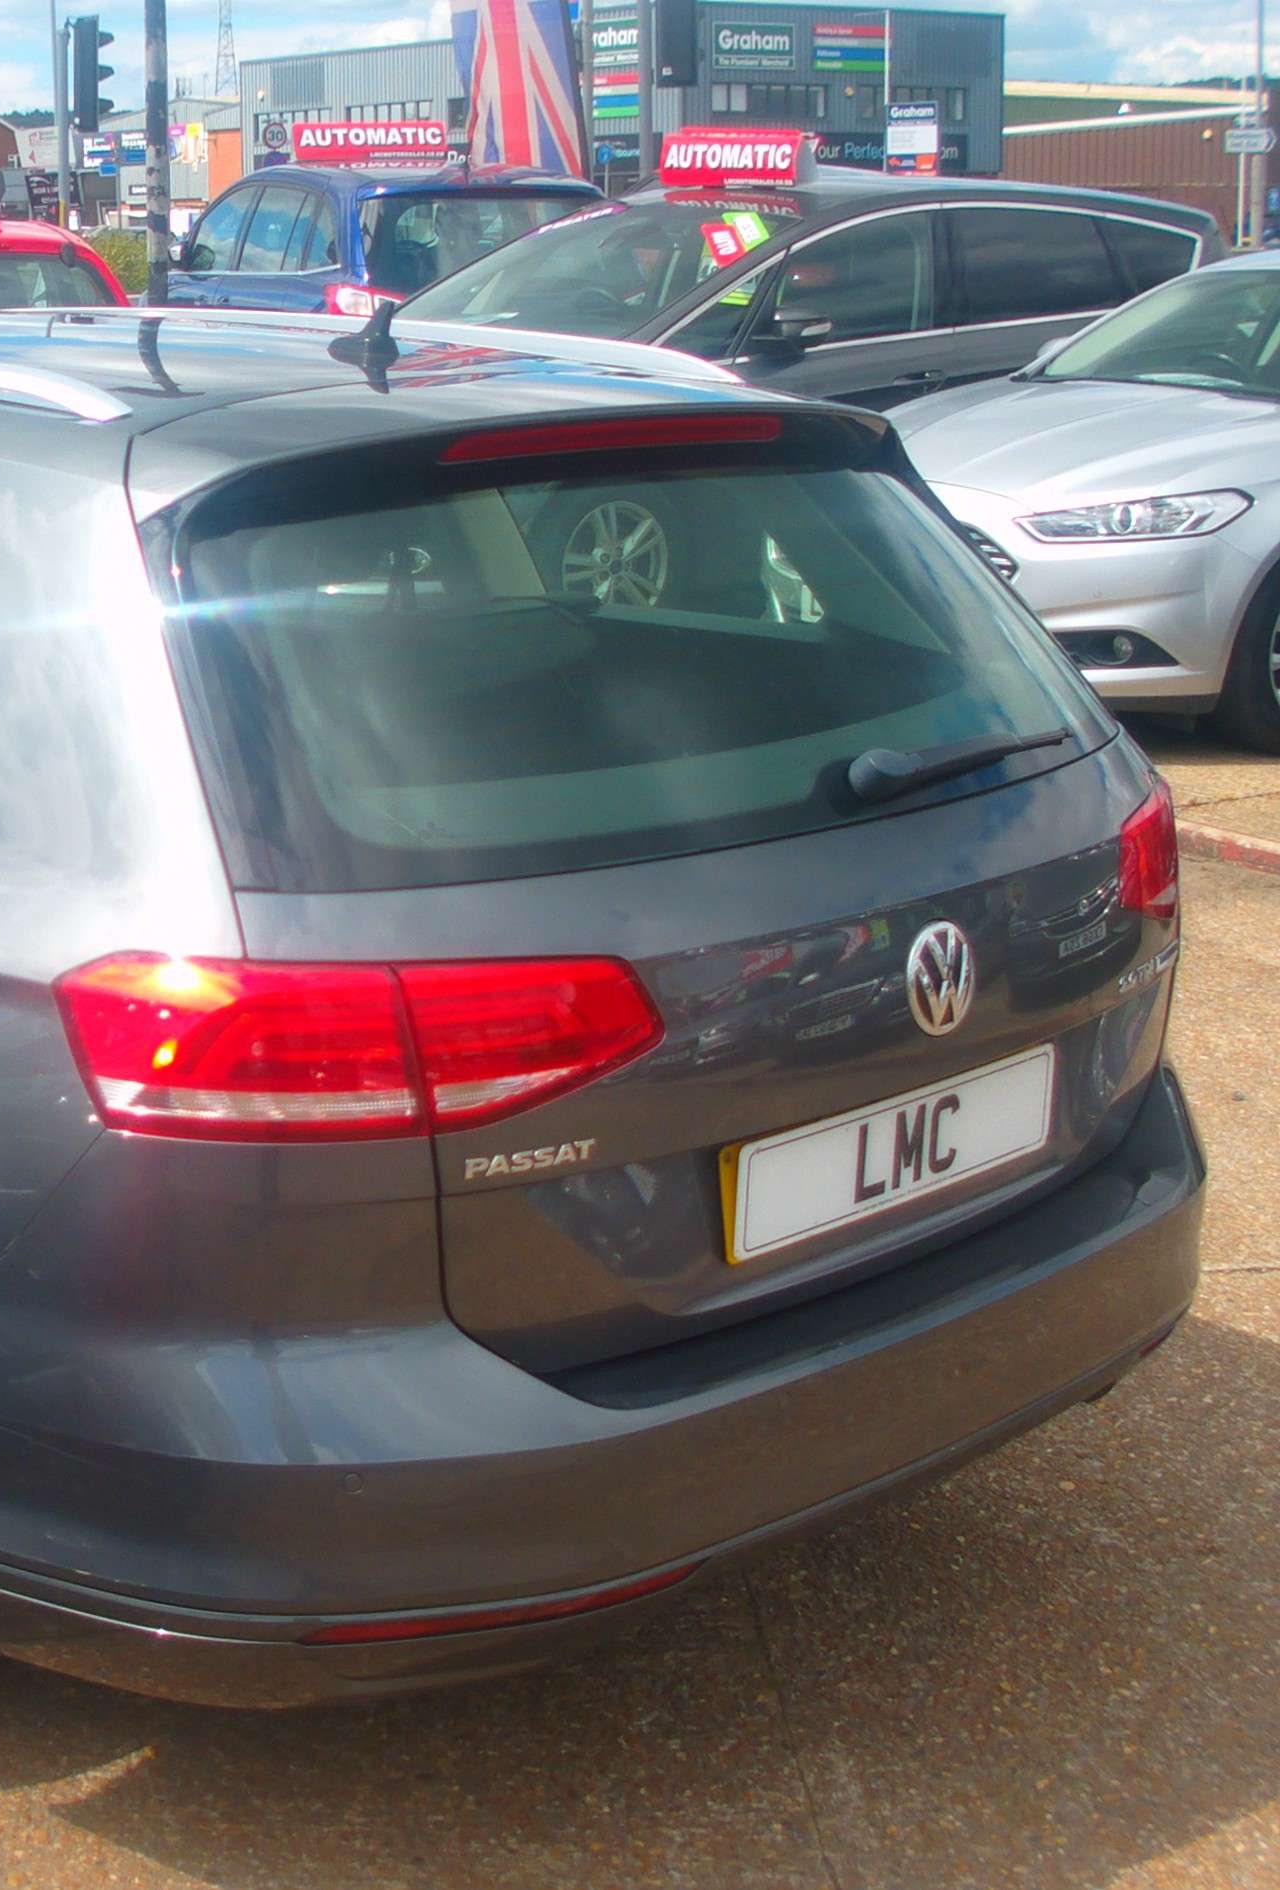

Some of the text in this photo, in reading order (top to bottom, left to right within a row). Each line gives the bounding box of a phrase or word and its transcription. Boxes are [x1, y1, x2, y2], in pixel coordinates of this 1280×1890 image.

[718, 29, 790, 51] Graham
[890, 106, 935, 118] Graham
[268, 129, 284, 142] 30
[300, 127, 443, 147] AUTOMATIC
[664, 144, 793, 170] AUTOMATIC
[464, 1138, 596, 1180] PASSAT
[853, 1096, 960, 1204] LMC
